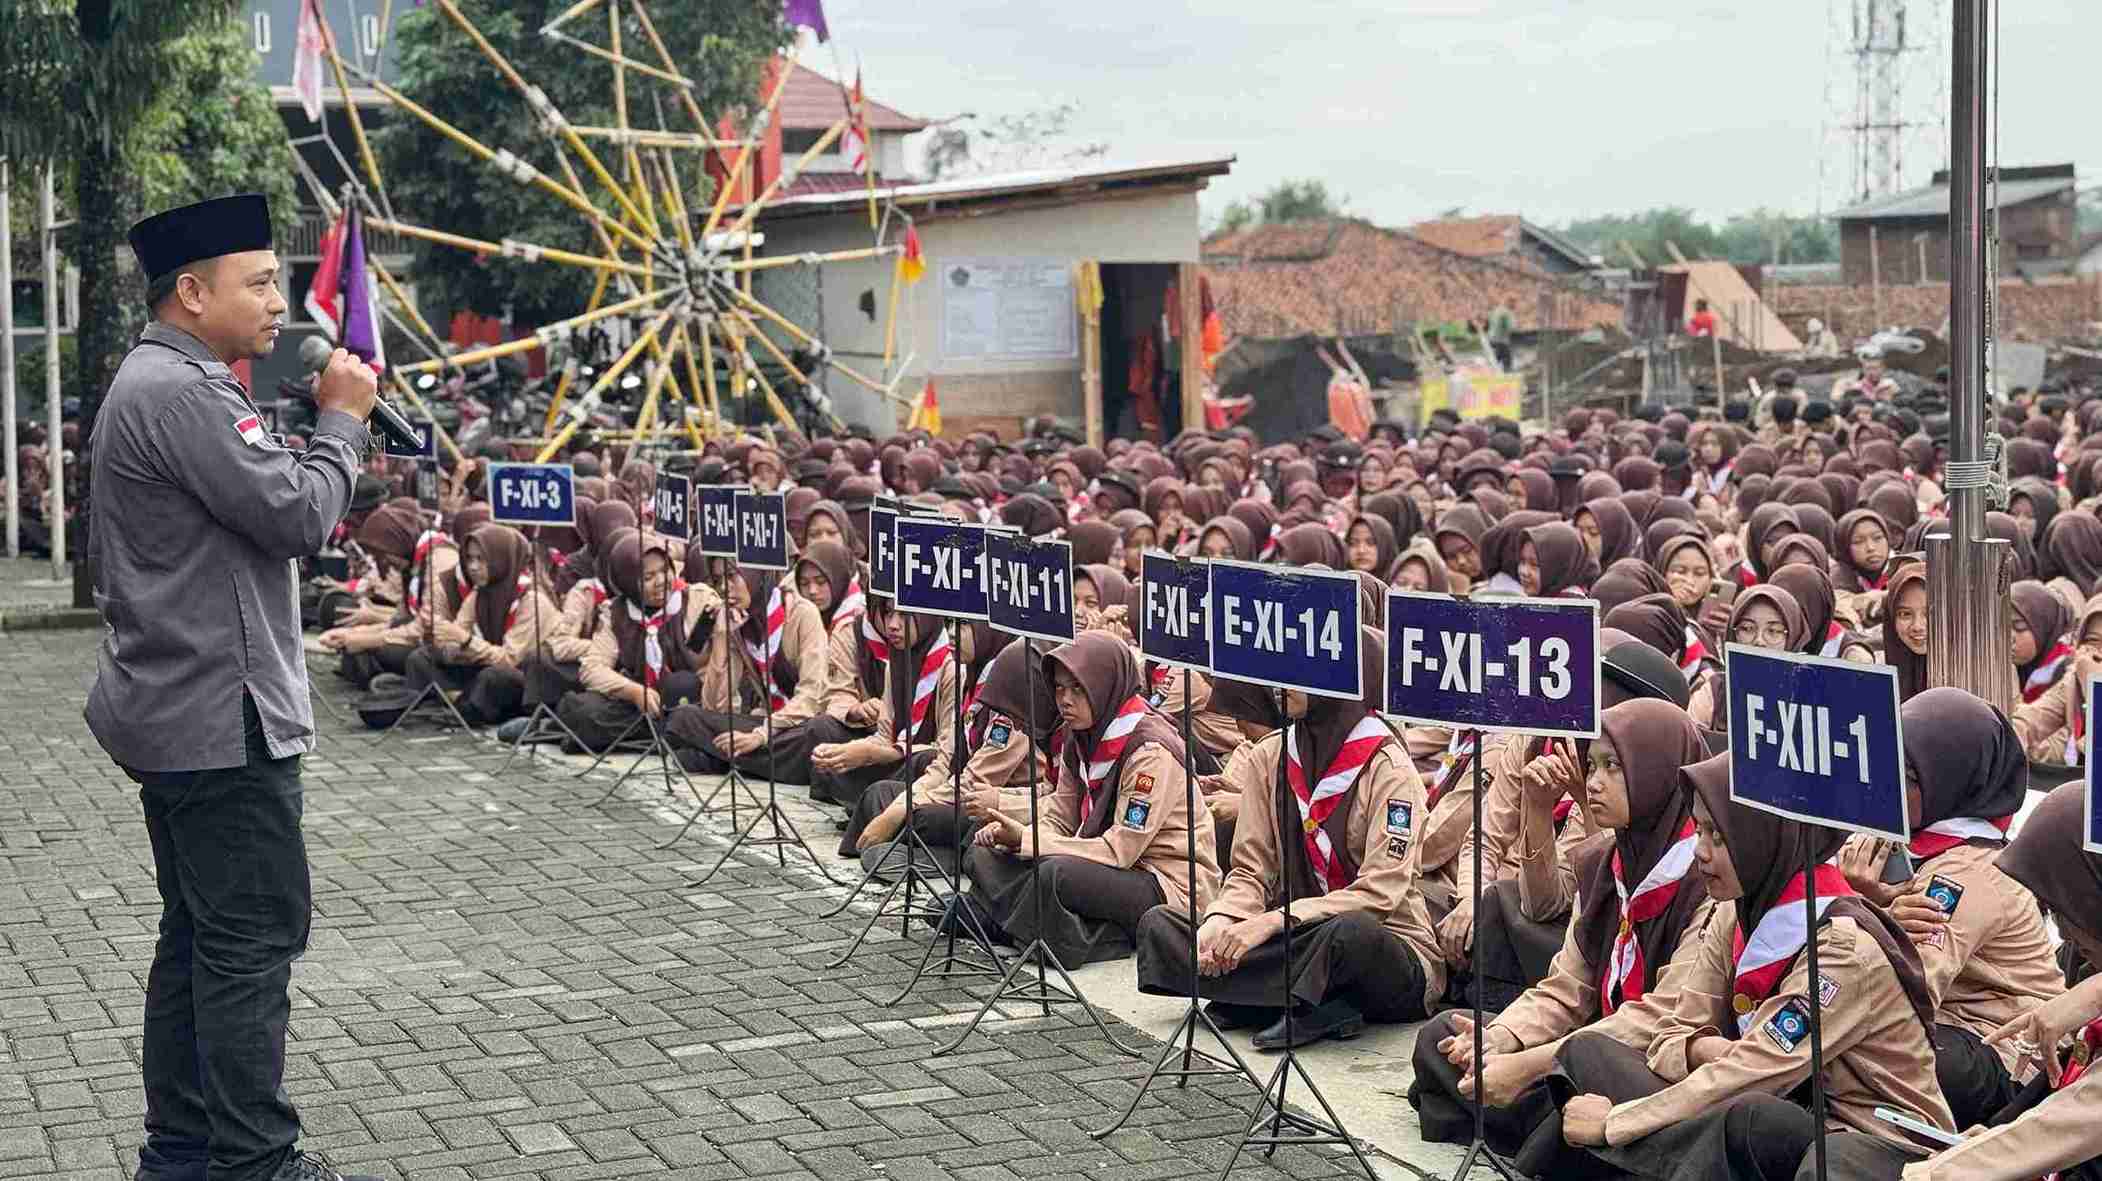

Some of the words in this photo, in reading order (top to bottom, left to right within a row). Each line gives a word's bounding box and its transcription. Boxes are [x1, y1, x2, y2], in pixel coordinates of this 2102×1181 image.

[501, 479, 561, 509] F-XI-3
[704, 503, 735, 536] F-XI-
[742, 512, 777, 548] F-XI-7
[905, 544, 988, 593] F-XI-1
[992, 557, 1066, 614] F-XI-11
[1147, 582, 1209, 641] F-XI-1
[1224, 595, 1342, 661] E-XI-14
[1402, 627, 1572, 699] F-XI-13
[1746, 693, 1870, 784] F-XII-1
